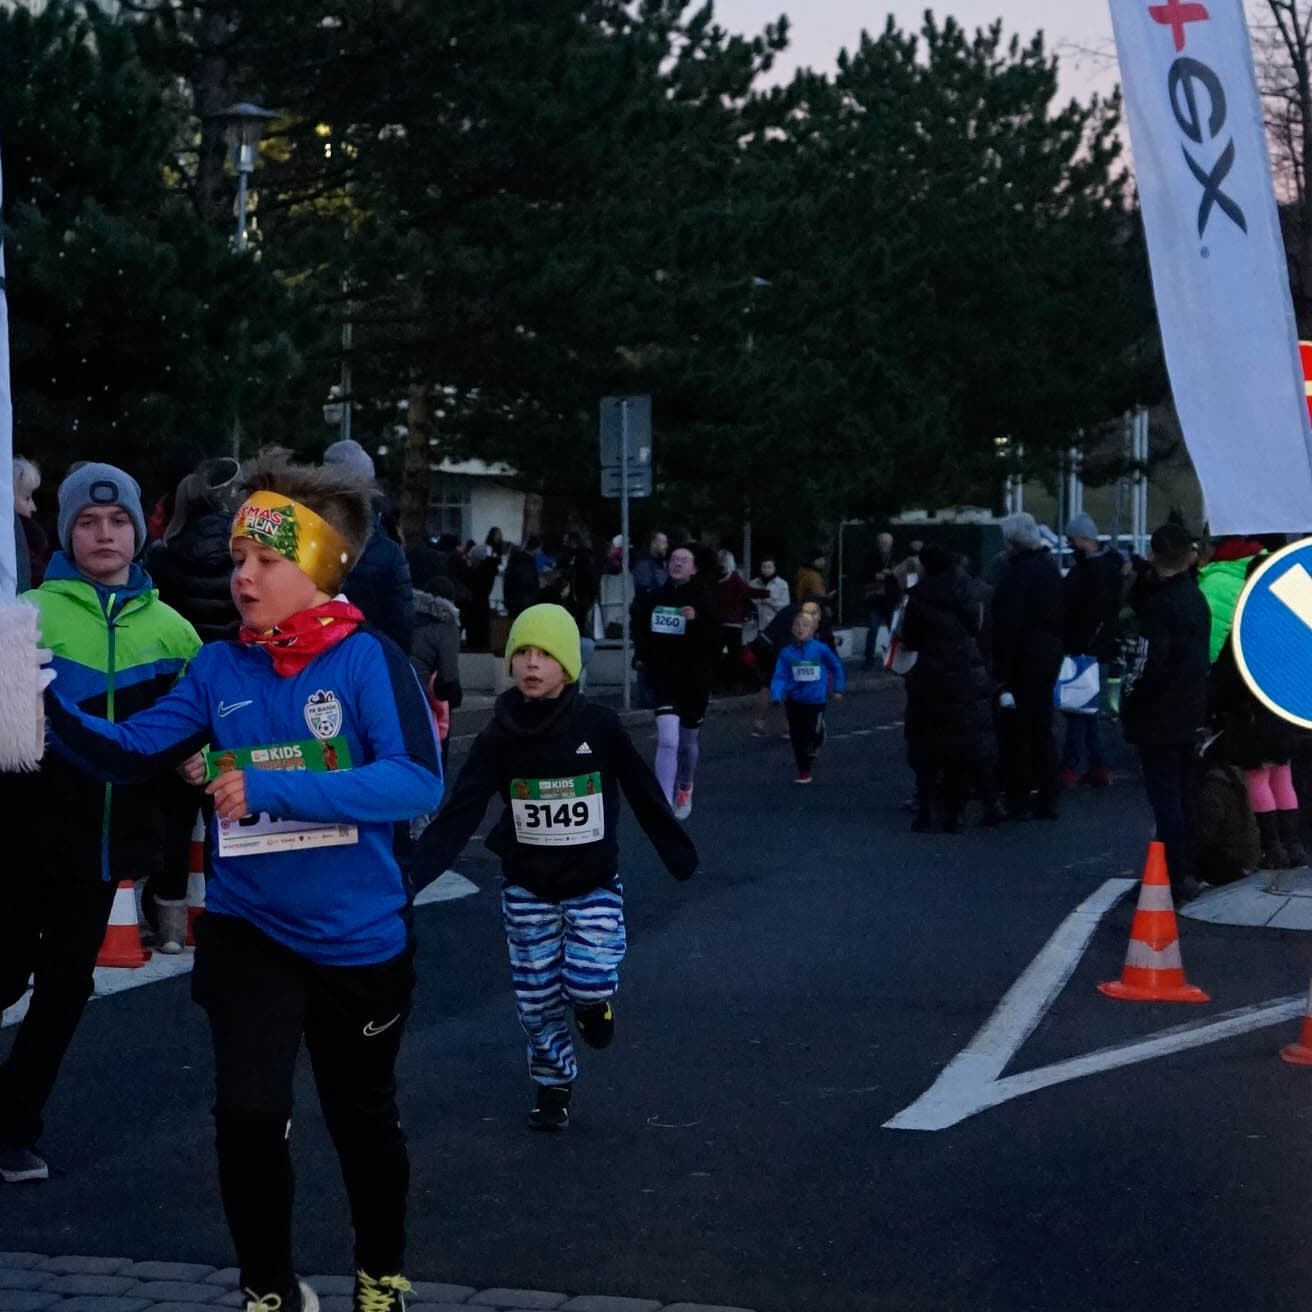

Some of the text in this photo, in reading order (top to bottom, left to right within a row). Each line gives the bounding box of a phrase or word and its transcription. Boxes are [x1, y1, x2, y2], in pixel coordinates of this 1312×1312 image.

[247, 516, 279, 536] RUN
[270, 745, 302, 760] KIDS
[552, 779, 575, 789] KIDS
[524, 801, 590, 829] 3149
